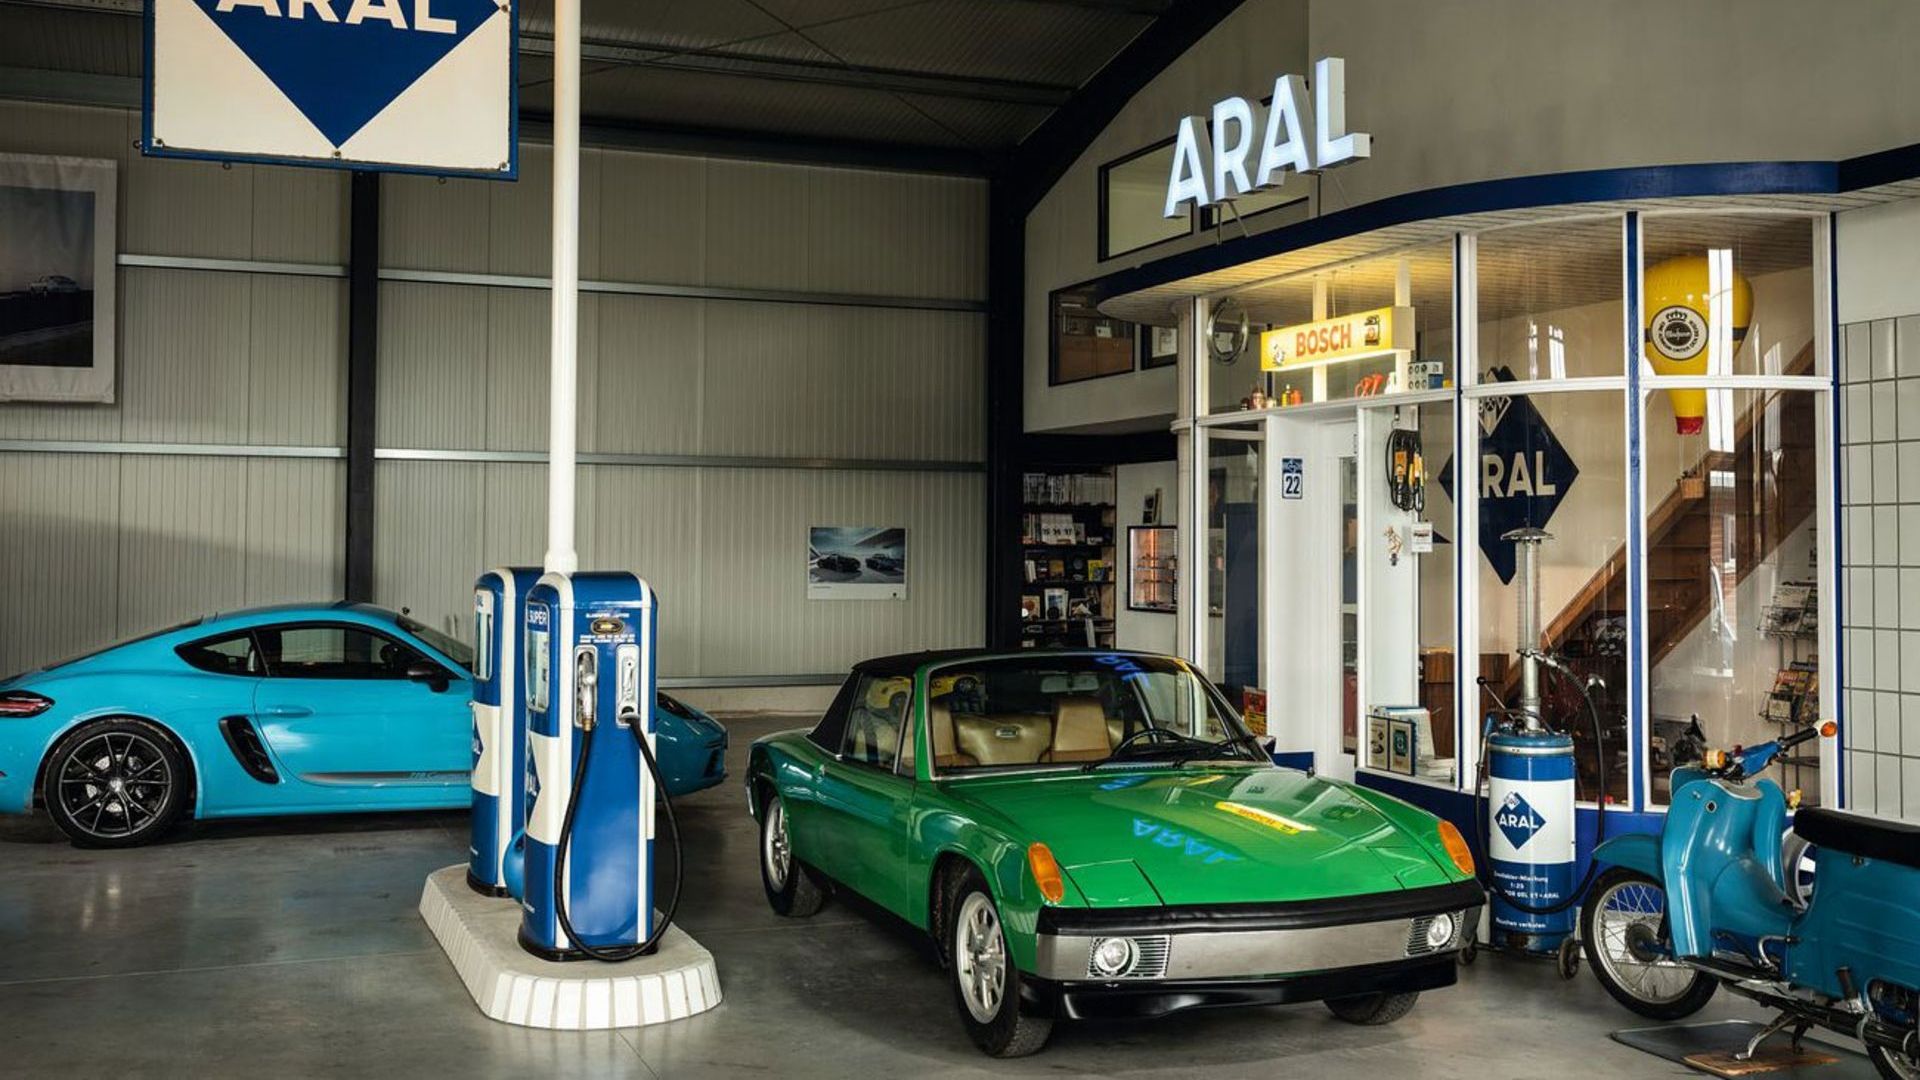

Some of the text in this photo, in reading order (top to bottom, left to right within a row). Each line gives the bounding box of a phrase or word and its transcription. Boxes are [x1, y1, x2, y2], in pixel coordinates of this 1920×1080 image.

[215, 0, 457, 34] AL
[1164, 58, 1370, 218] ARAL
[1296, 323, 1351, 357] BOSCH
[1285, 475, 1300, 494] 22
[1480, 451, 1556, 498] RAL
[528, 609, 548, 625] SUPER
[1499, 813, 1539, 829] ARAL
